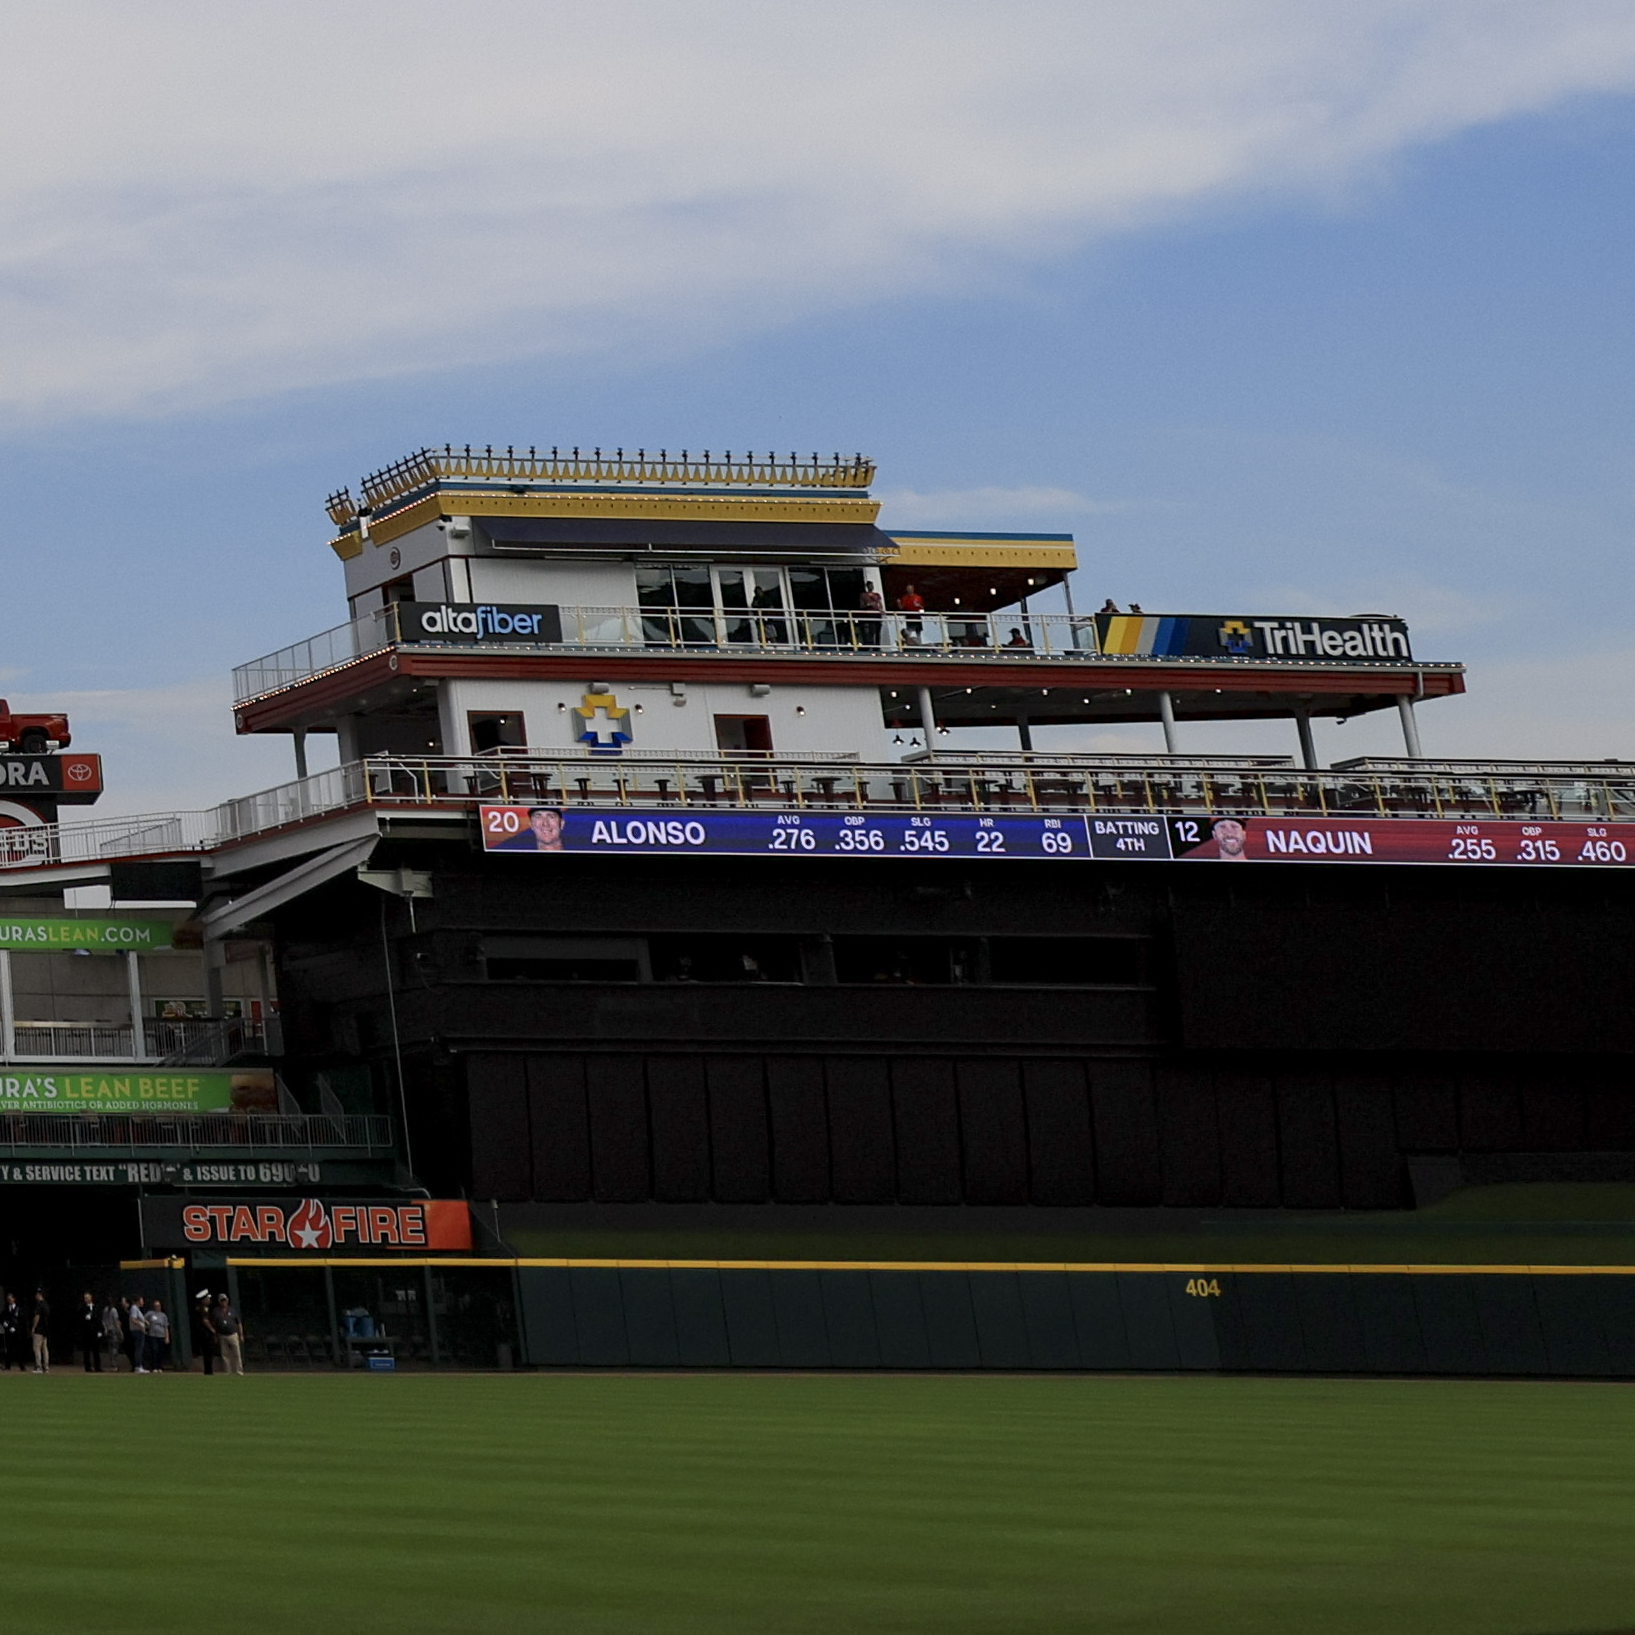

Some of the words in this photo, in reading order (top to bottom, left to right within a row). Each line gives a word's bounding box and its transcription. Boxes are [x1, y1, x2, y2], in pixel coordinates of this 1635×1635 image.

[421, 605, 542, 639] altafiber
[1254, 621, 1408, 657] TriHealth
[592, 821, 705, 844] ALONSO
[1095, 821, 1159, 836] BATTING
[769, 830, 815, 850] .276
[1267, 830, 1372, 855] NAQUIN
[1448, 839, 1496, 860] .255
[65, 1077, 131, 1099] LEAN
[140, 1077, 200, 1099] BEEF
[22, 1101, 86, 1110] ANTIBIOTICS
[88, 1101, 104, 1110] OR
[106, 1101, 139, 1110] ADDED
[142, 1101, 199, 1110] HORMONES
[13, 1166, 23, 1180] &
[27, 1166, 81, 1181] SERVICE
[84, 1167, 115, 1181] TEXT
[184, 1205, 285, 1242] STAR
[331, 1205, 425, 1244] FIRE
[1185, 1278, 1221, 1297] 404
